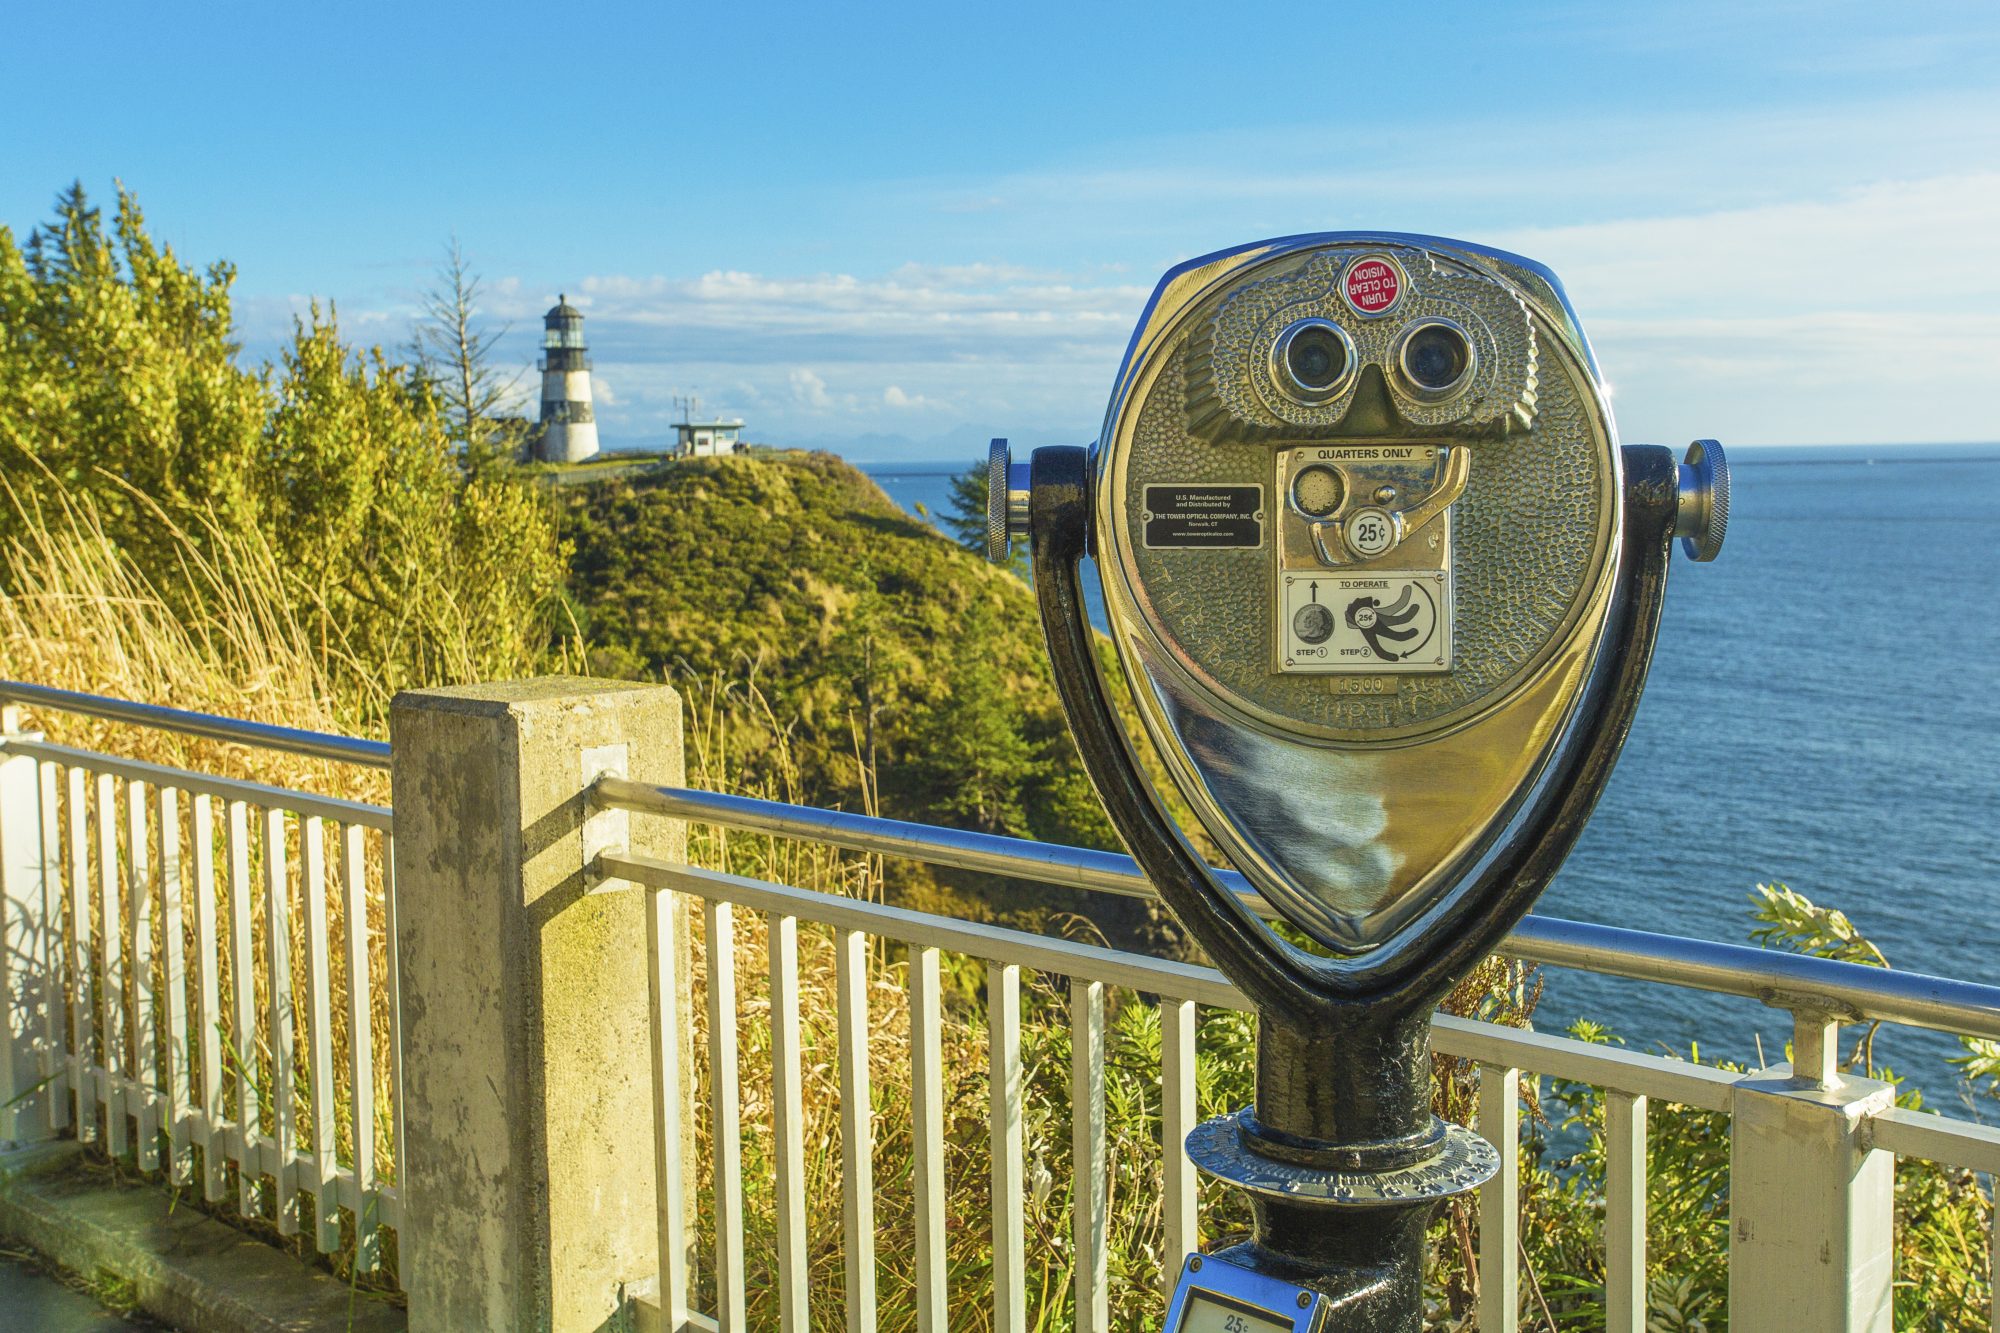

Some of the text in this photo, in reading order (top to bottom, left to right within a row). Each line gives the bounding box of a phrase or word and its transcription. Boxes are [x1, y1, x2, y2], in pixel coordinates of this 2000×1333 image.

[1354, 266, 1386, 280] VISION
[1349, 278, 1396, 294] TO CLEAR
[1362, 292, 1388, 305] TURN
[1318, 449, 1412, 459] QUARTERS ONLY
[1358, 524, 1386, 542] 25¢
[1352, 580, 1388, 588] OPERATE
